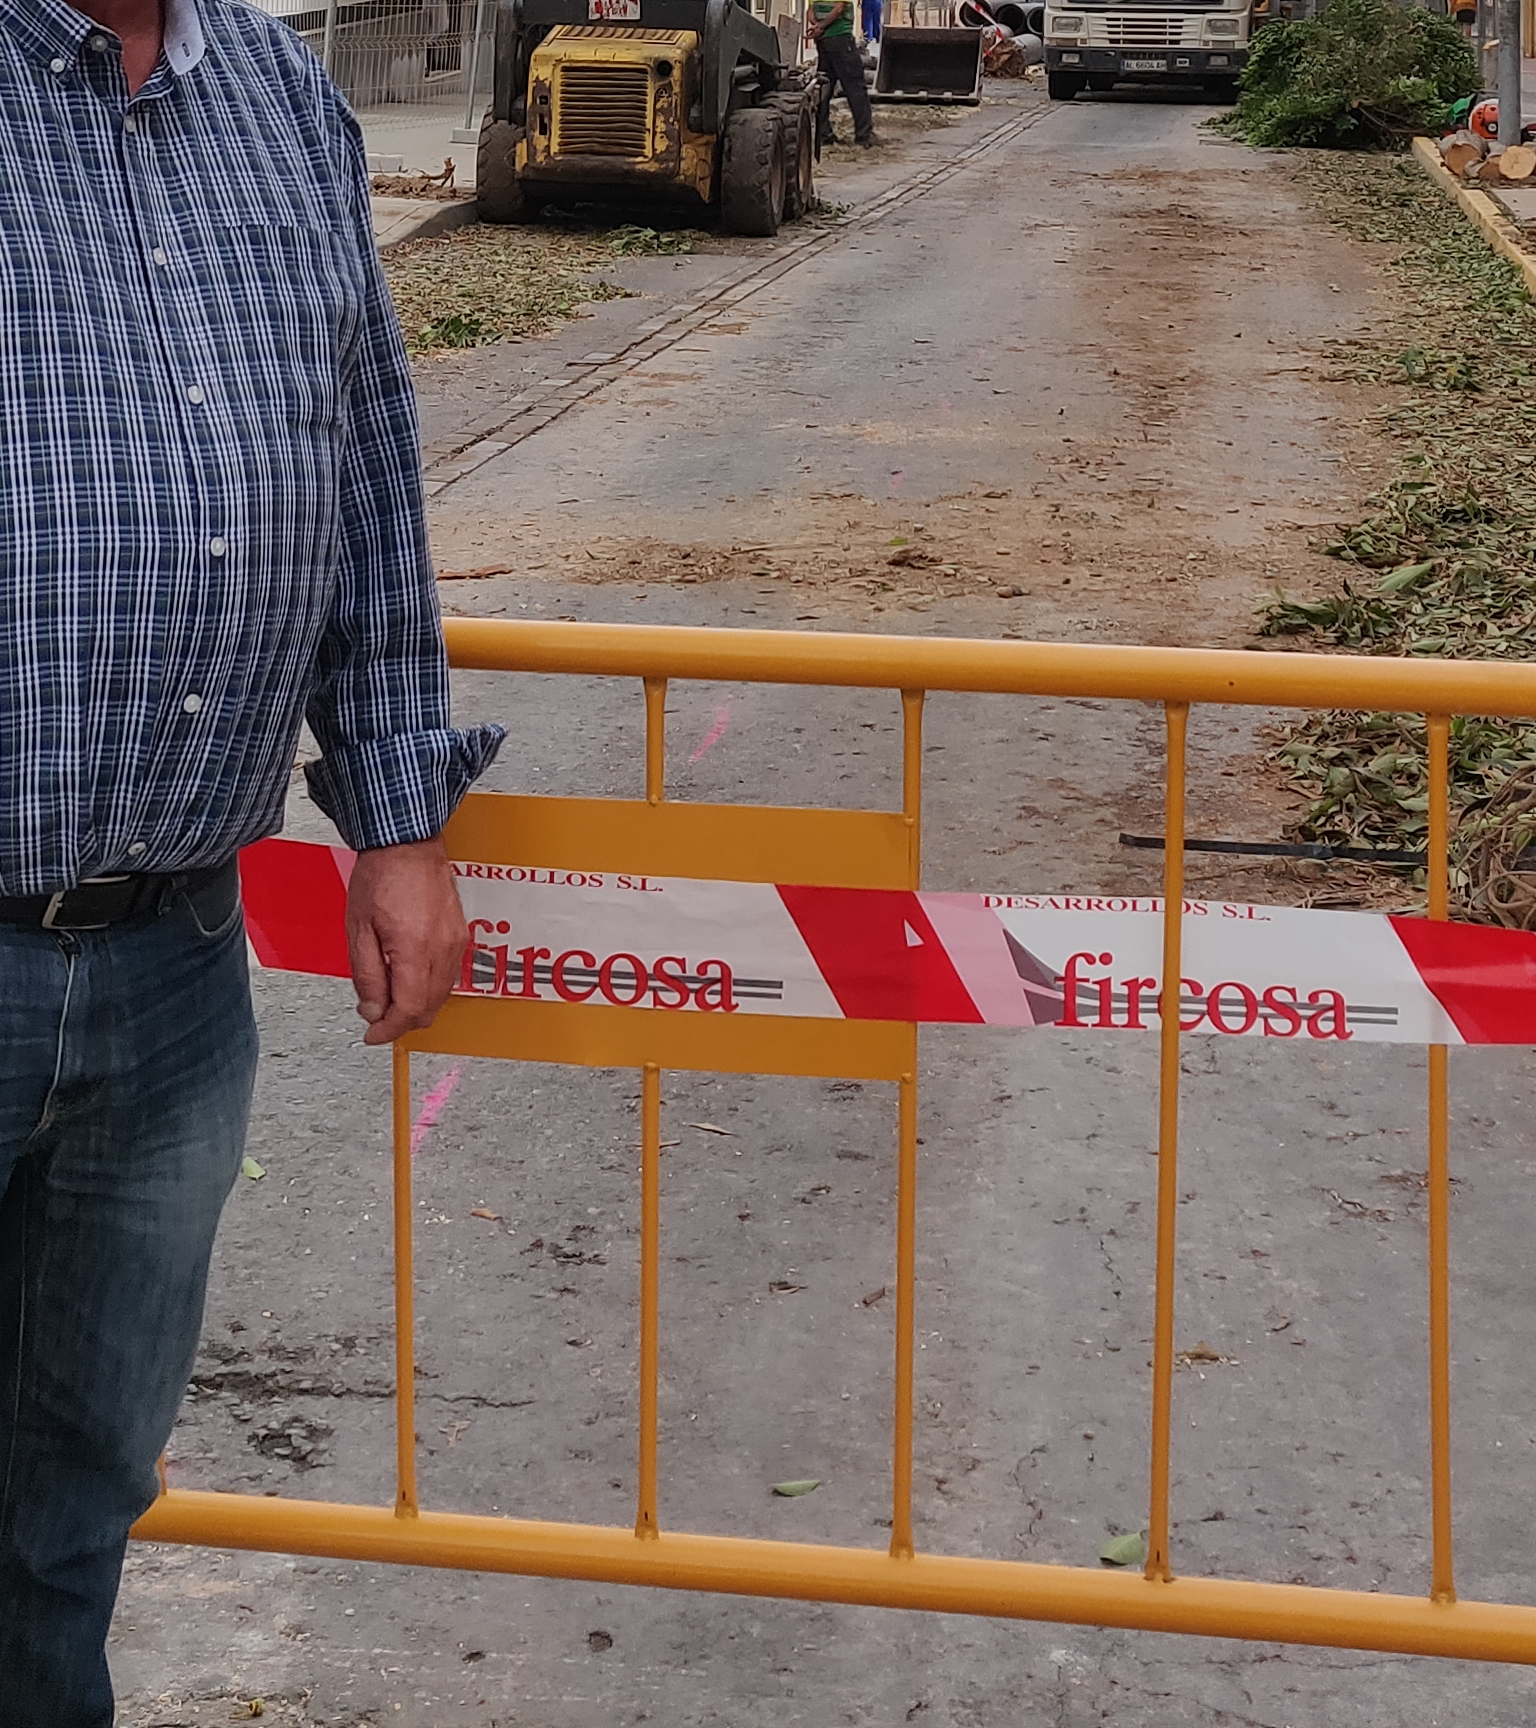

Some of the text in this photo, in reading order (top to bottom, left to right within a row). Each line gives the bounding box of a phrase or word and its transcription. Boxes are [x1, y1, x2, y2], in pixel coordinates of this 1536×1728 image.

[451, 863, 664, 892] ARROLLOS S.L.
[1222, 904, 1272, 922] S.L.
[453, 918, 740, 1013] fircosa
[1053, 951, 1354, 1041] fircosa
